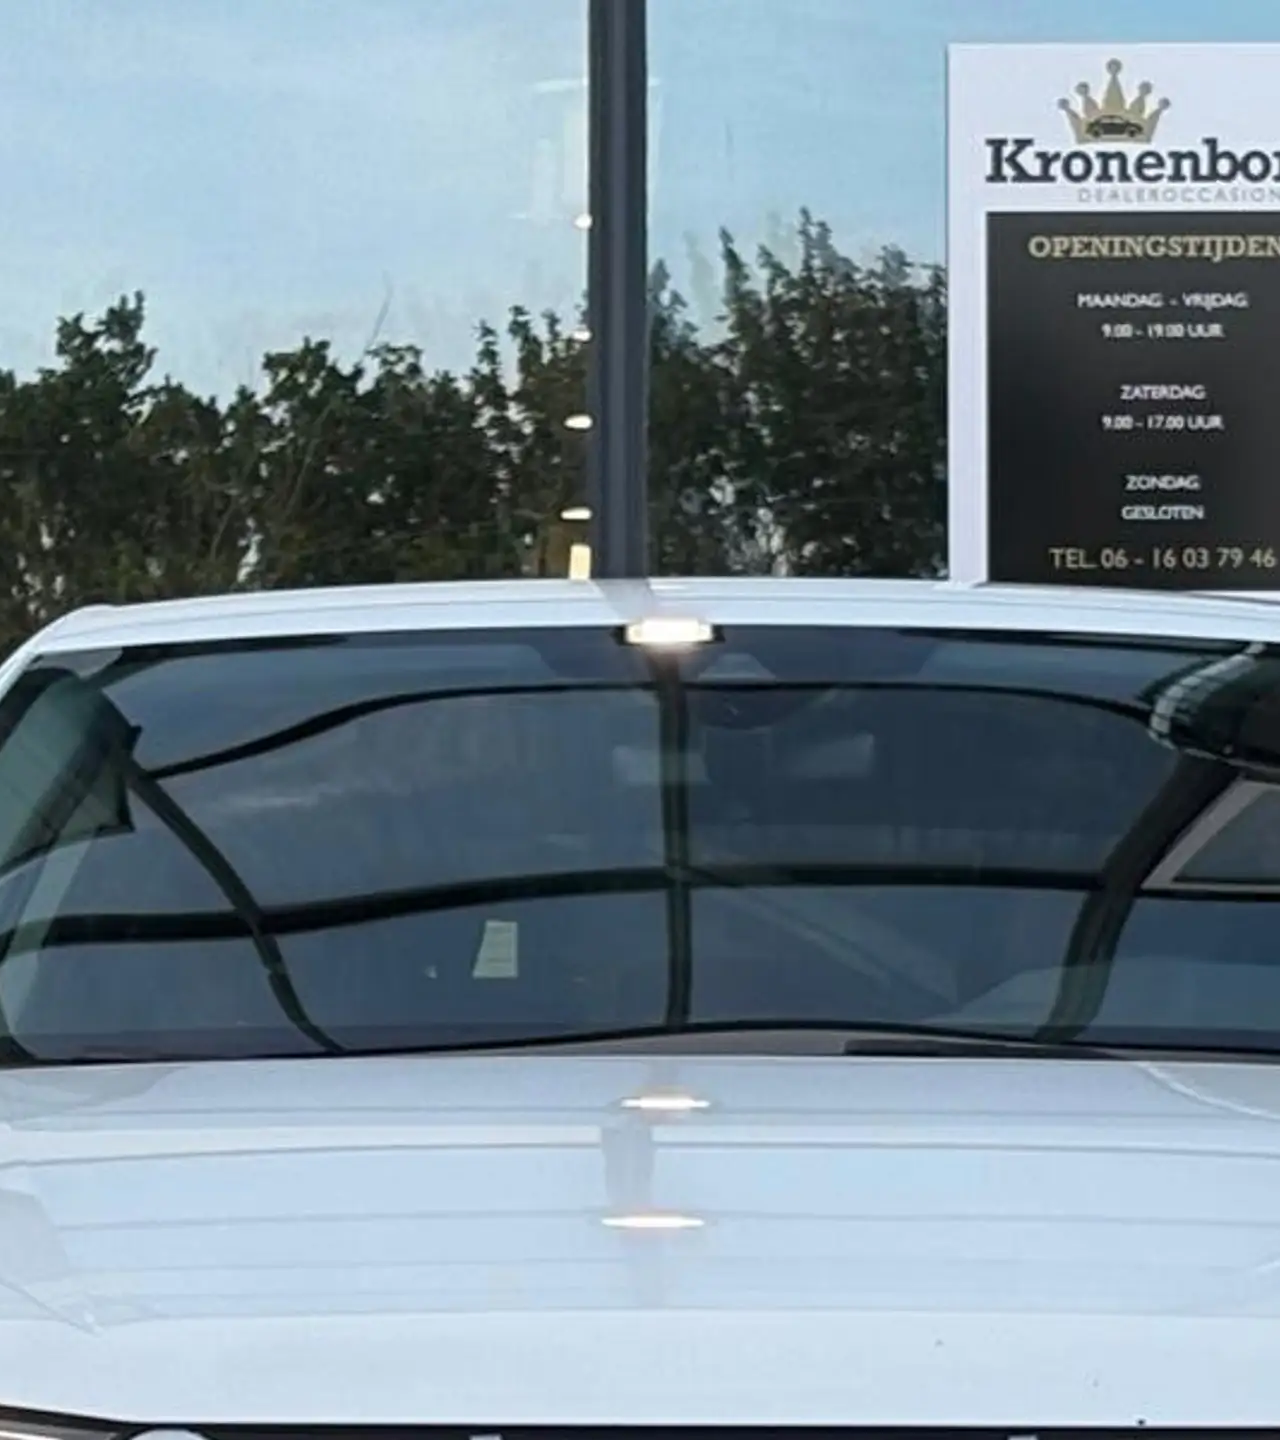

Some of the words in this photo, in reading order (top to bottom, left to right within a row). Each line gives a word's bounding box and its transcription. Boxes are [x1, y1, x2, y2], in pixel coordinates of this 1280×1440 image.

[1077, 292, 1164, 308] MAANDAG
[1182, 292, 1249, 311] VRIJDAG
[1187, 323, 1225, 338] UUR
[1120, 384, 1206, 400] ZATERDAG
[1187, 415, 1224, 430] UUR
[1125, 474, 1201, 490] ZONDAG
[1121, 505, 1205, 520] GESLOTEN
[1100, 547, 1129, 569] 06
[1152, 547, 1177, 569] 16
[1182, 547, 1210, 569] 03
[1216, 547, 1244, 569] 79
[1249, 547, 1278, 569] 46
